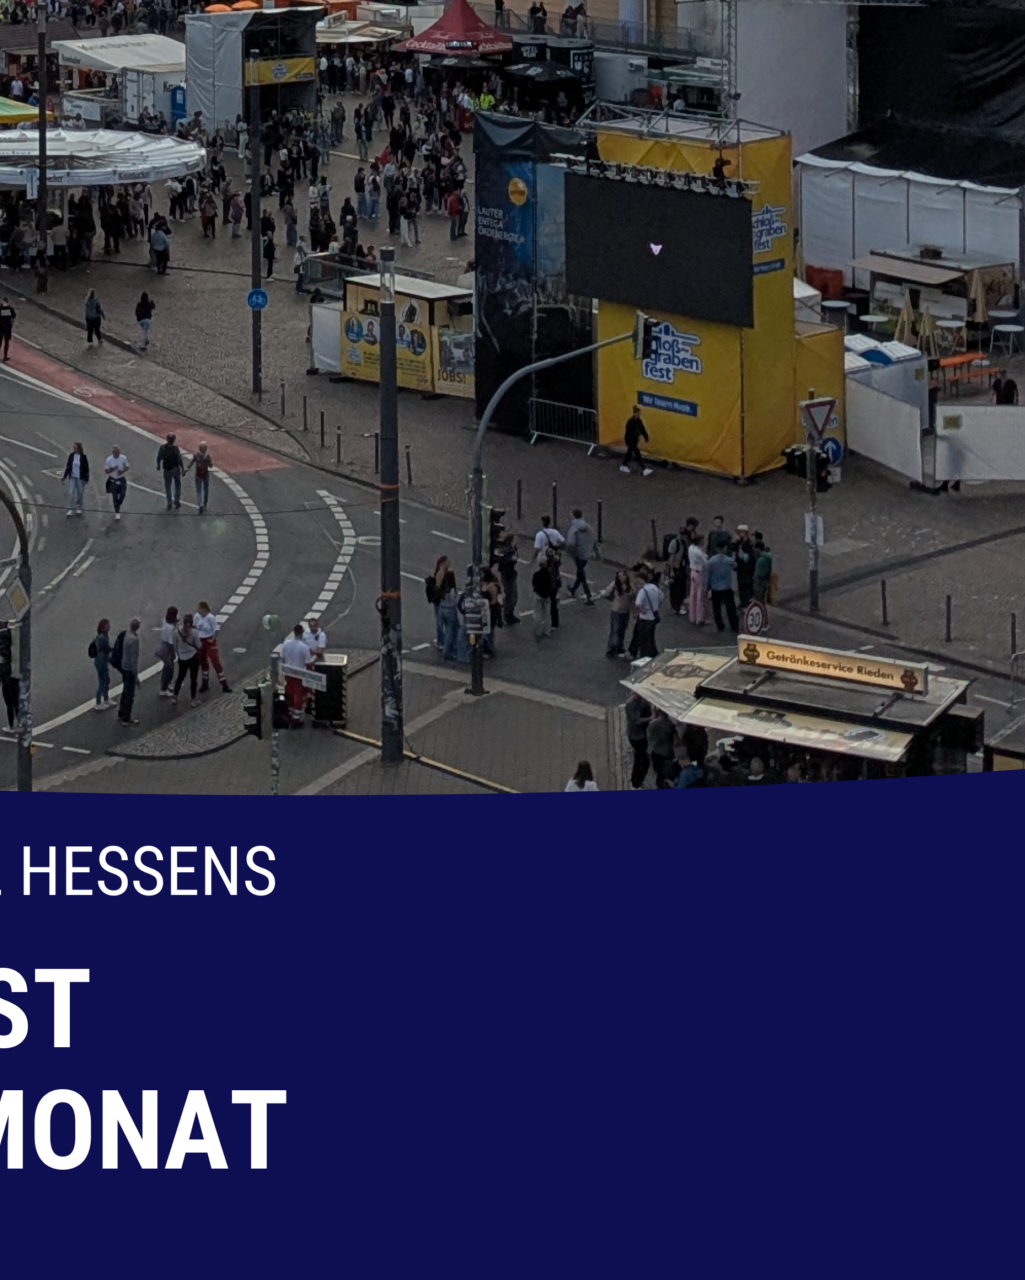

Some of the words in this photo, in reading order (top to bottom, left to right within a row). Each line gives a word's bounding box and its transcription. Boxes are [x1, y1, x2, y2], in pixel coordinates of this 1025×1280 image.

[437, 369, 467, 384] JOBS!
[644, 360, 673, 381] fest
[748, 612, 761, 628] 30
[766, 649, 854, 675] Getränkeservice
[856, 665, 894, 681] Rieden
